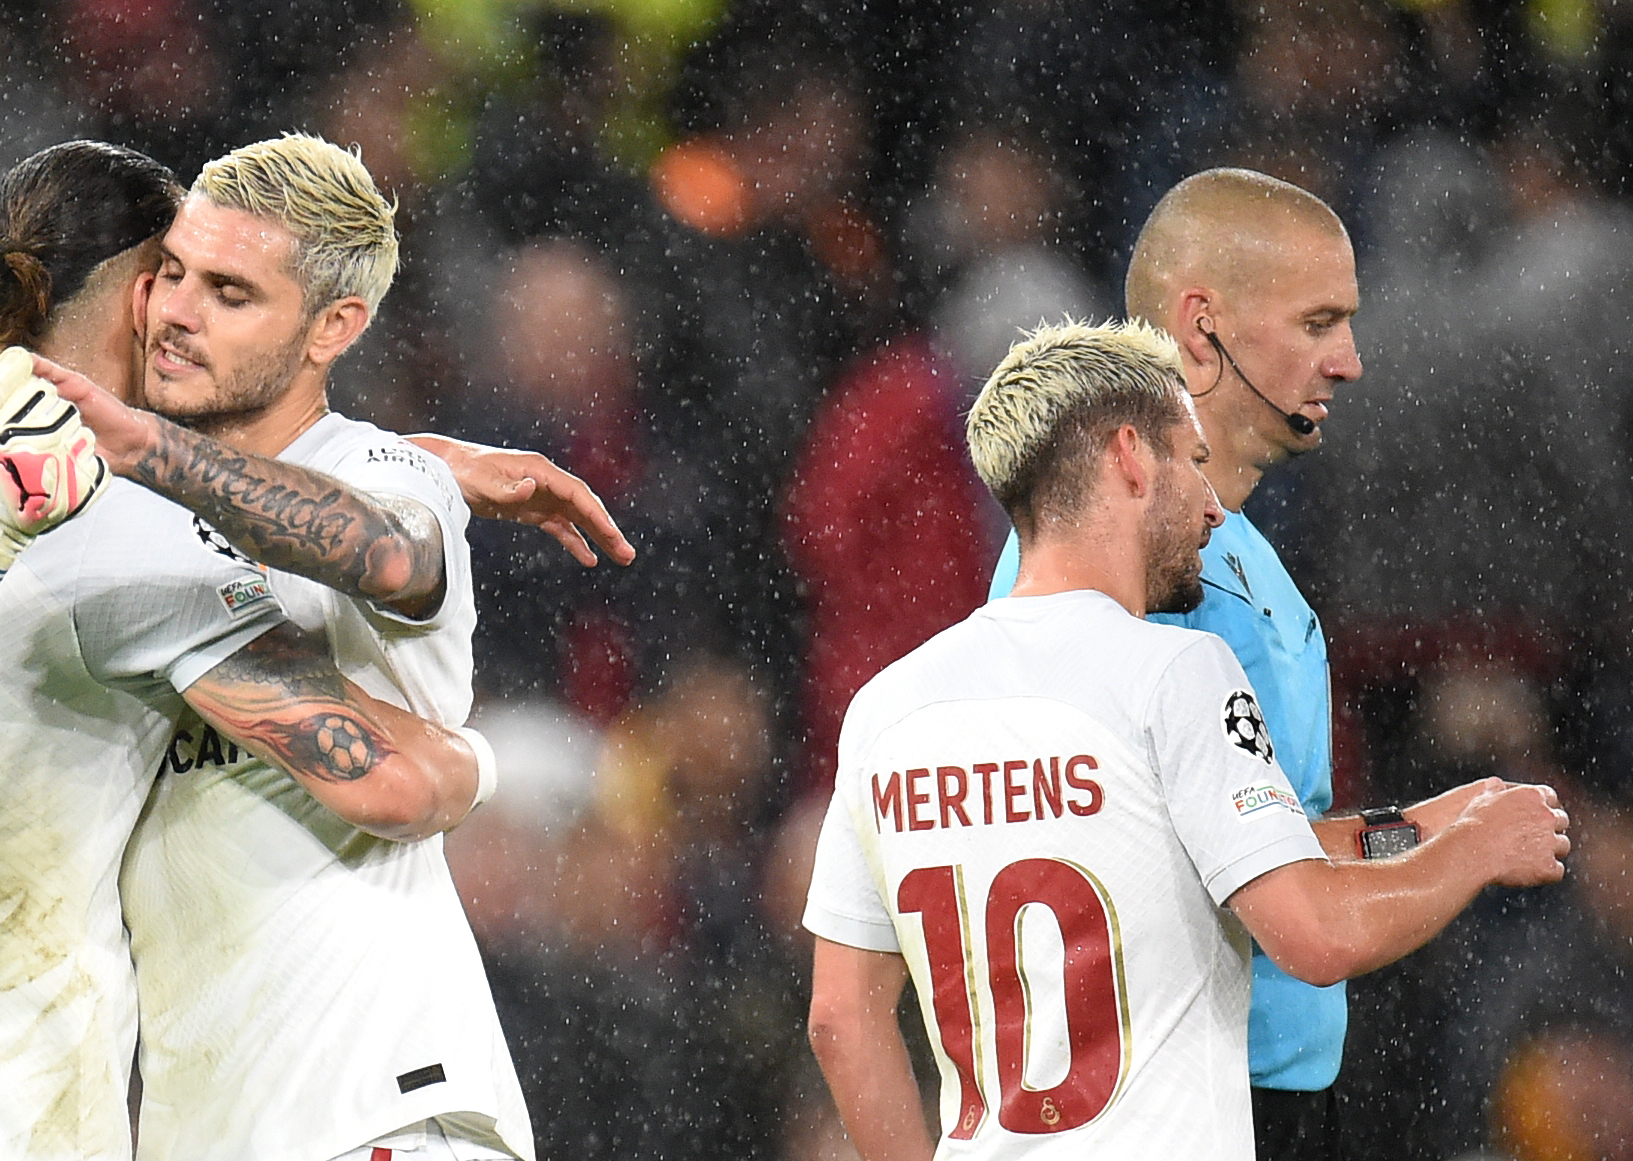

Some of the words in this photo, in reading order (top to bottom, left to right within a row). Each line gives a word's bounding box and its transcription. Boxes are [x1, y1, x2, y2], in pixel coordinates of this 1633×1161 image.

[224, 584, 270, 608] FOUN
[871, 754, 1106, 836] MERTENS
[897, 857, 1132, 1141] 10
